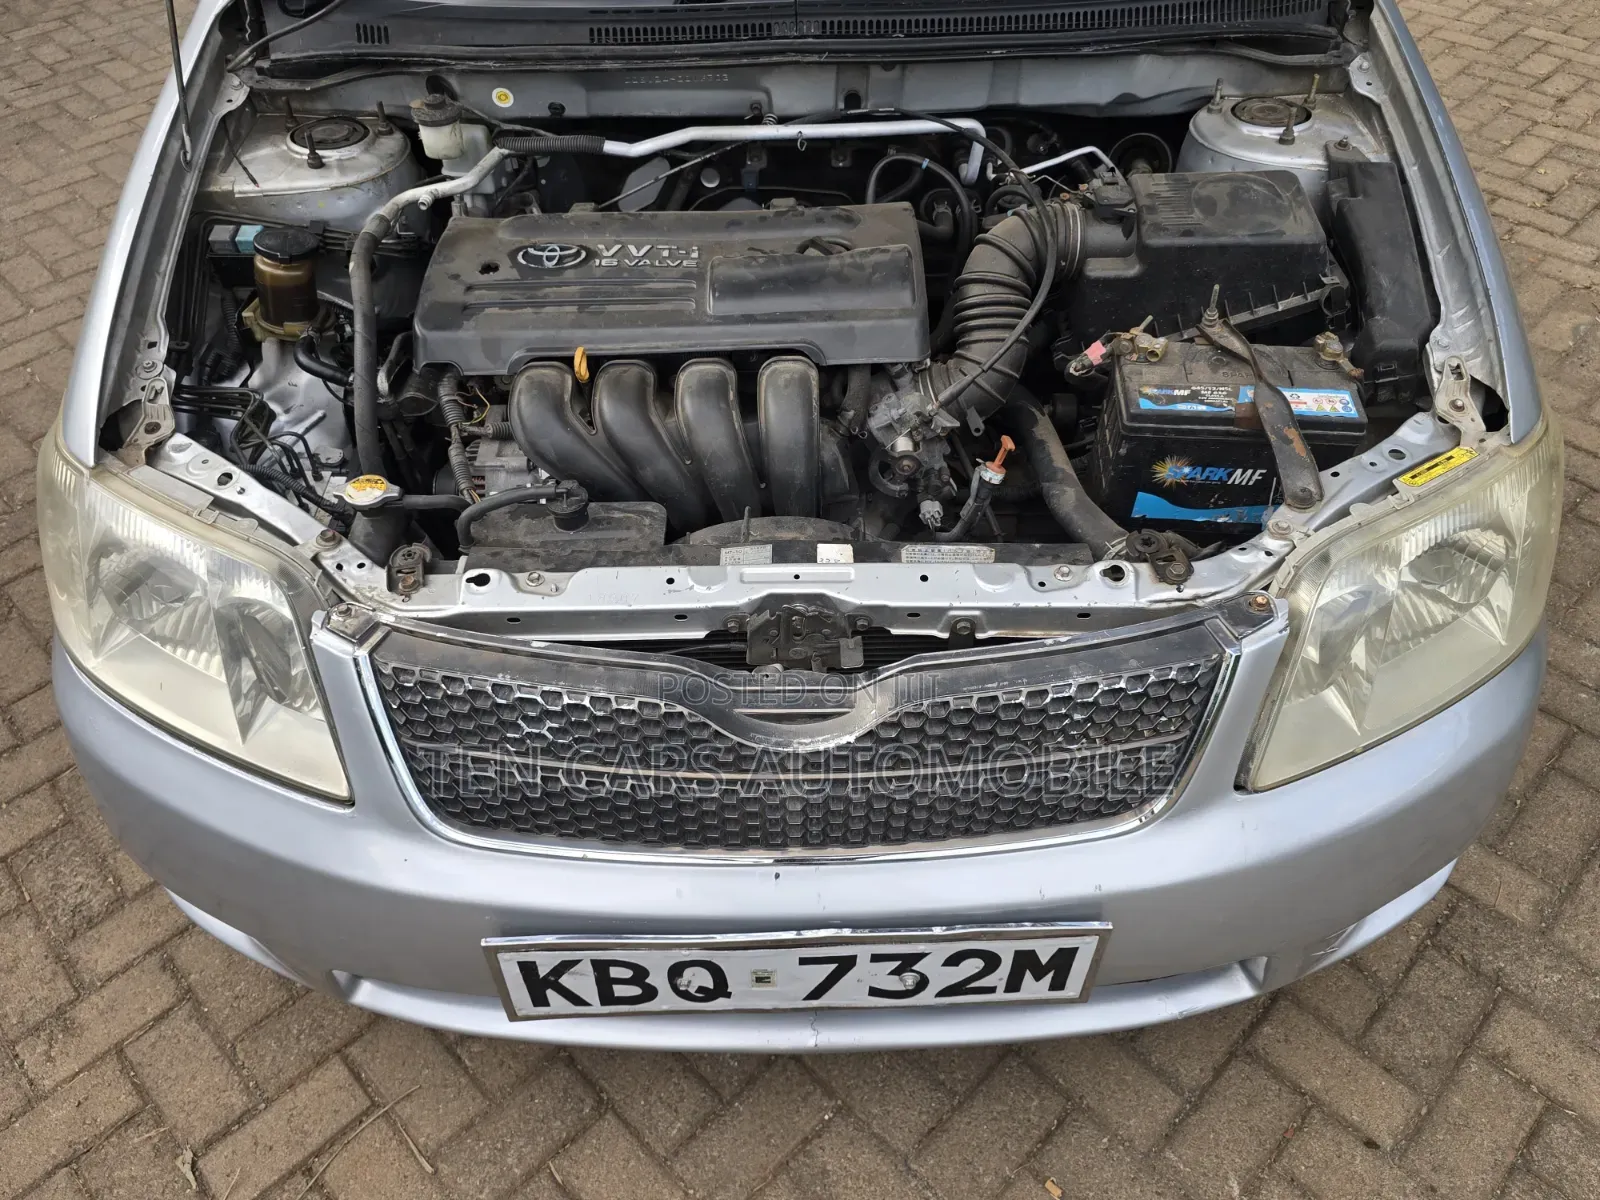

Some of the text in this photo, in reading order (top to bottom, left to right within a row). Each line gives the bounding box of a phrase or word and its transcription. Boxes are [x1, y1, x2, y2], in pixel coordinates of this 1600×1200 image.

[596, 244, 699, 259] VVT-i
[594, 259, 698, 267] 16 VALVE
[516, 946, 1080, 1008] KBQ 732M
